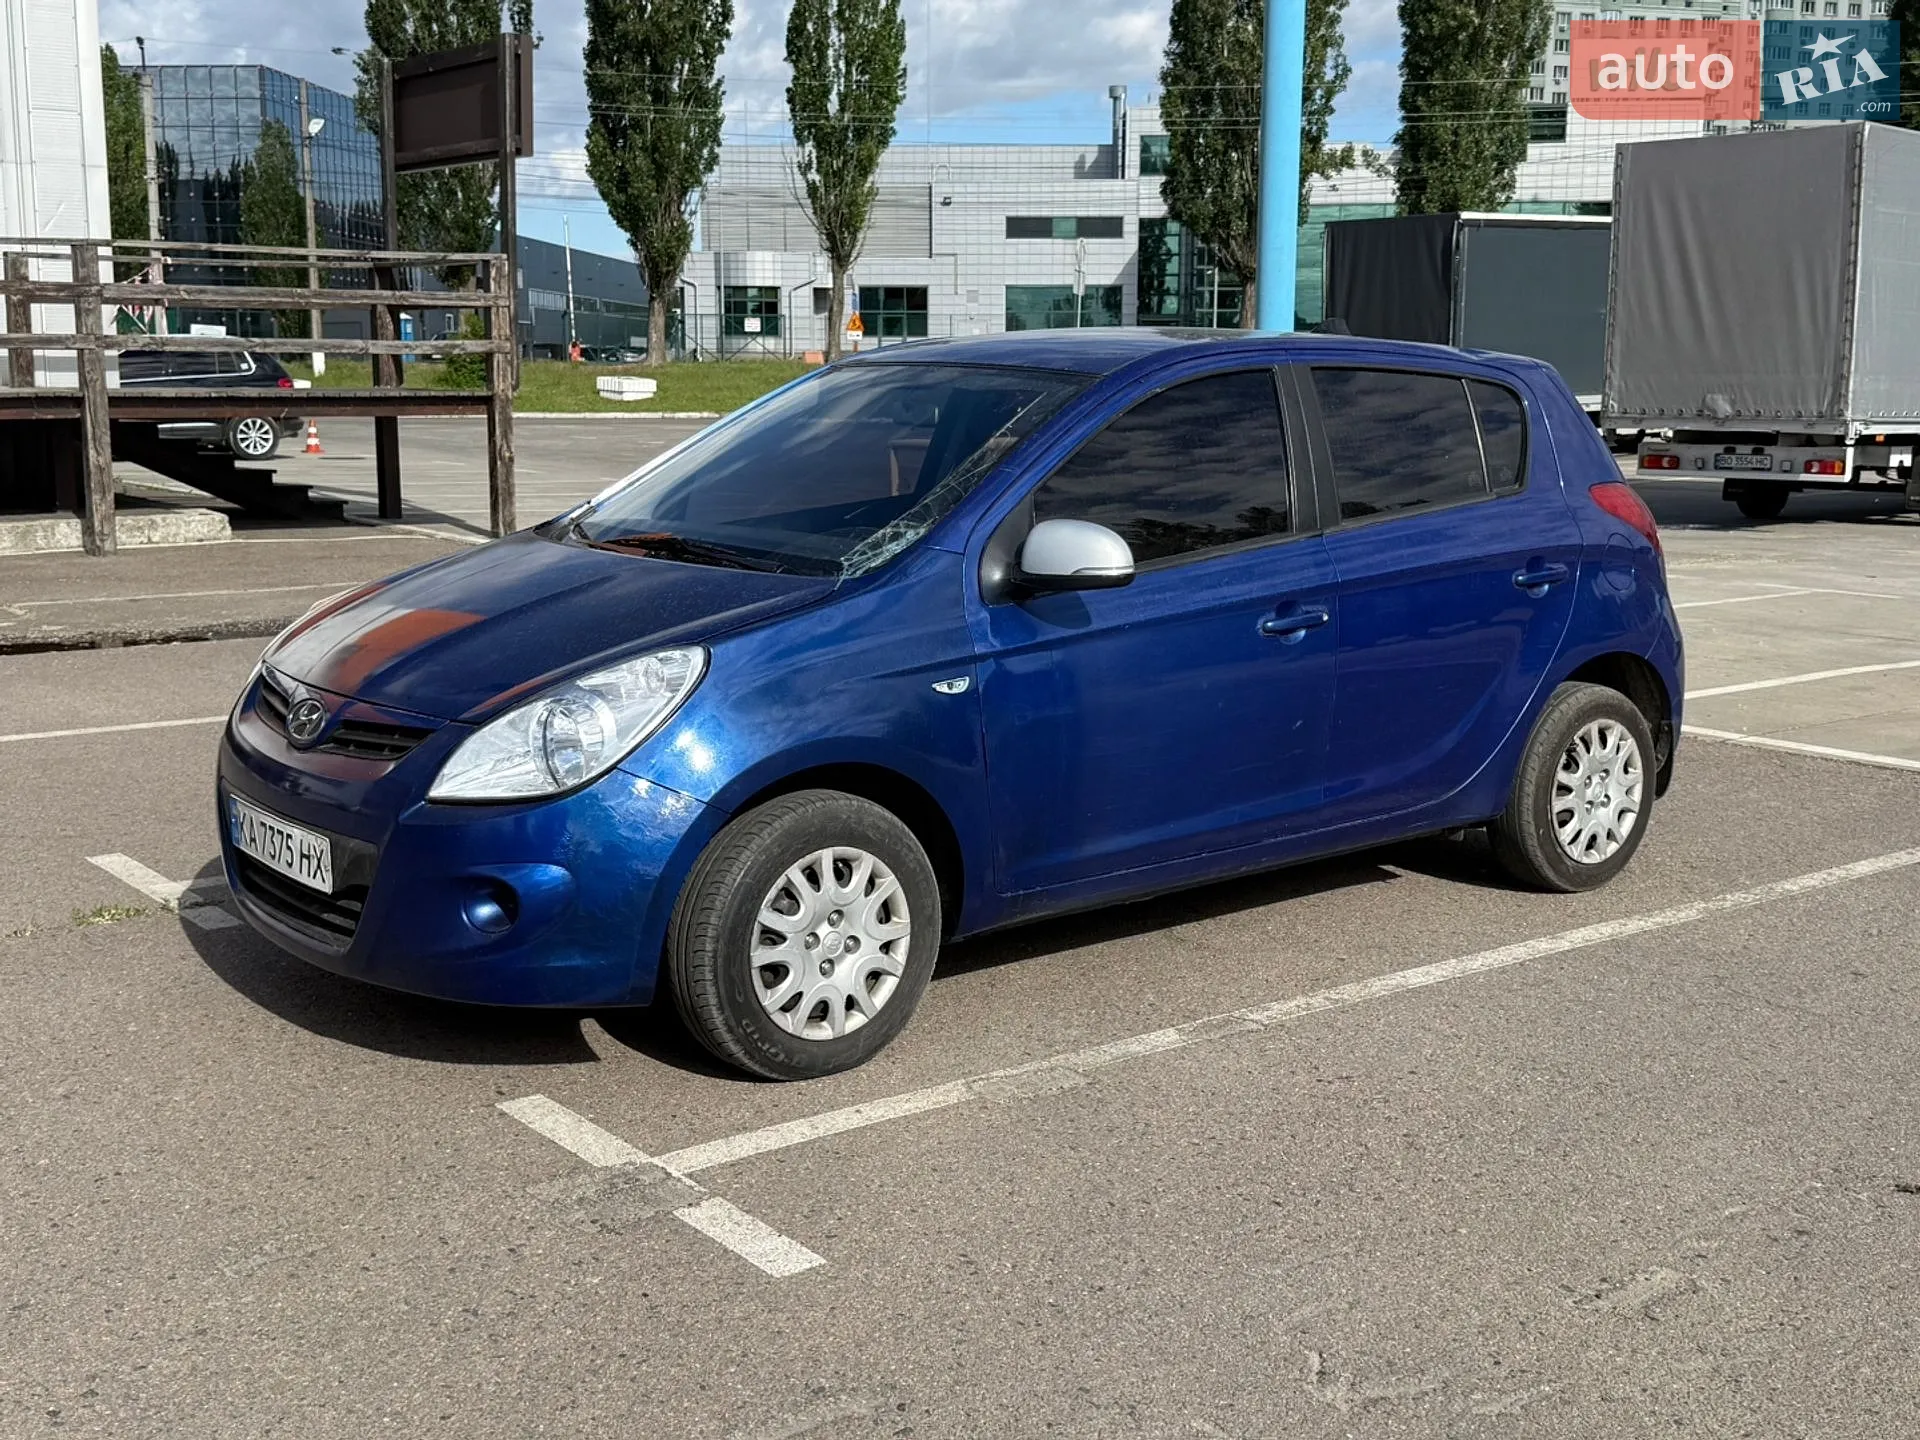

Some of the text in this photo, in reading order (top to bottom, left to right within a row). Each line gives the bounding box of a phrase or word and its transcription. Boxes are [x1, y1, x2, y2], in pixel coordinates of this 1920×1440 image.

[239, 811, 327, 884] KA 7375 HX
